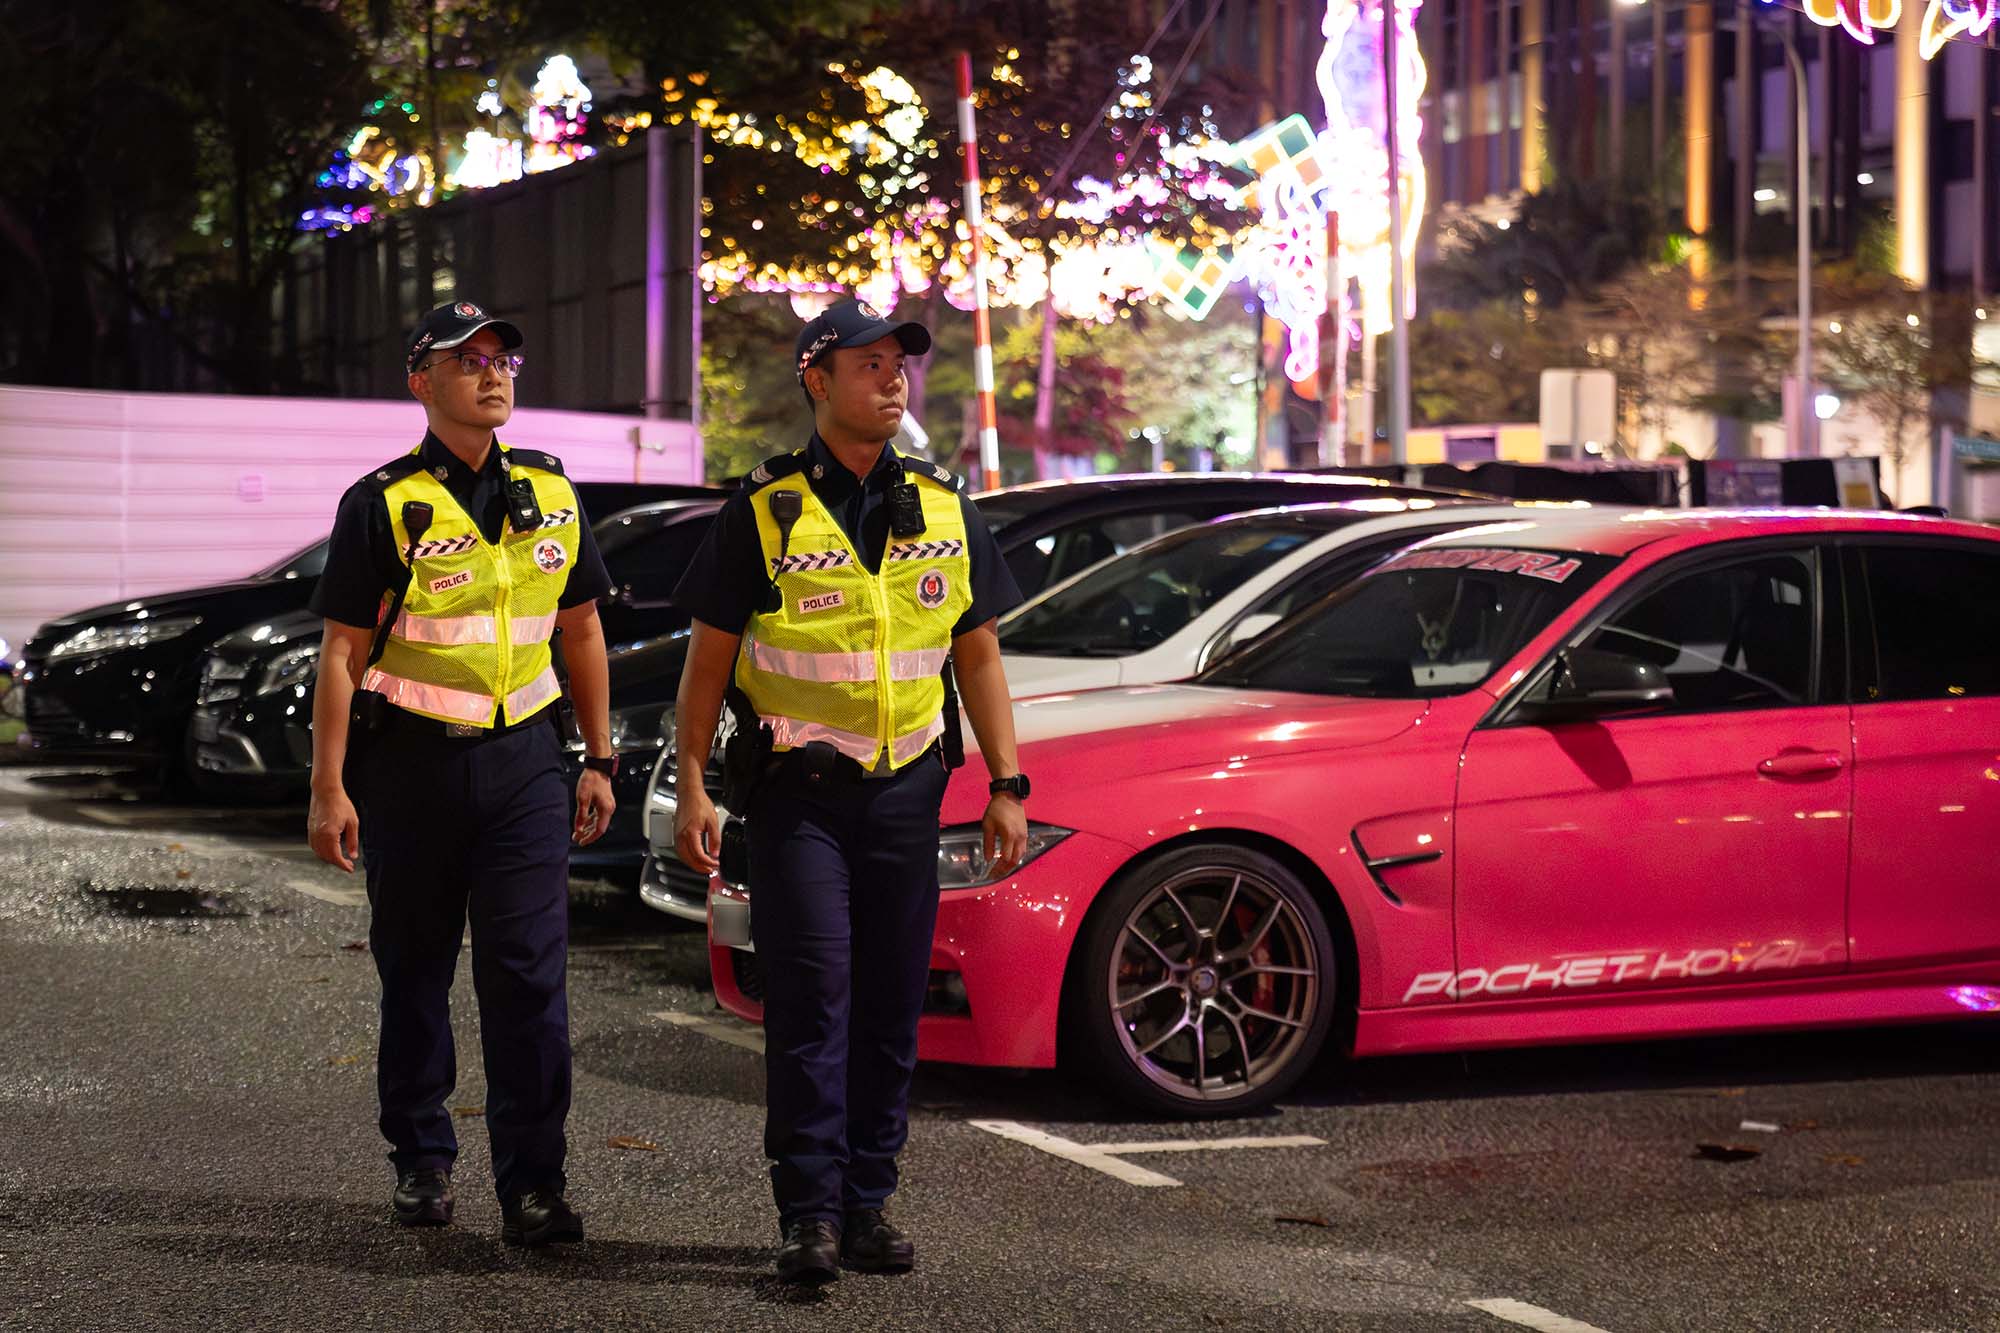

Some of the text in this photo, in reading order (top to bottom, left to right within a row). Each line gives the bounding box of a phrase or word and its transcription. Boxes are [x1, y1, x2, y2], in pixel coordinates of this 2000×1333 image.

[434, 573, 469, 591] POLICE
[803, 594, 840, 611] POLICE
[1402, 955, 1647, 1003] POCKET
